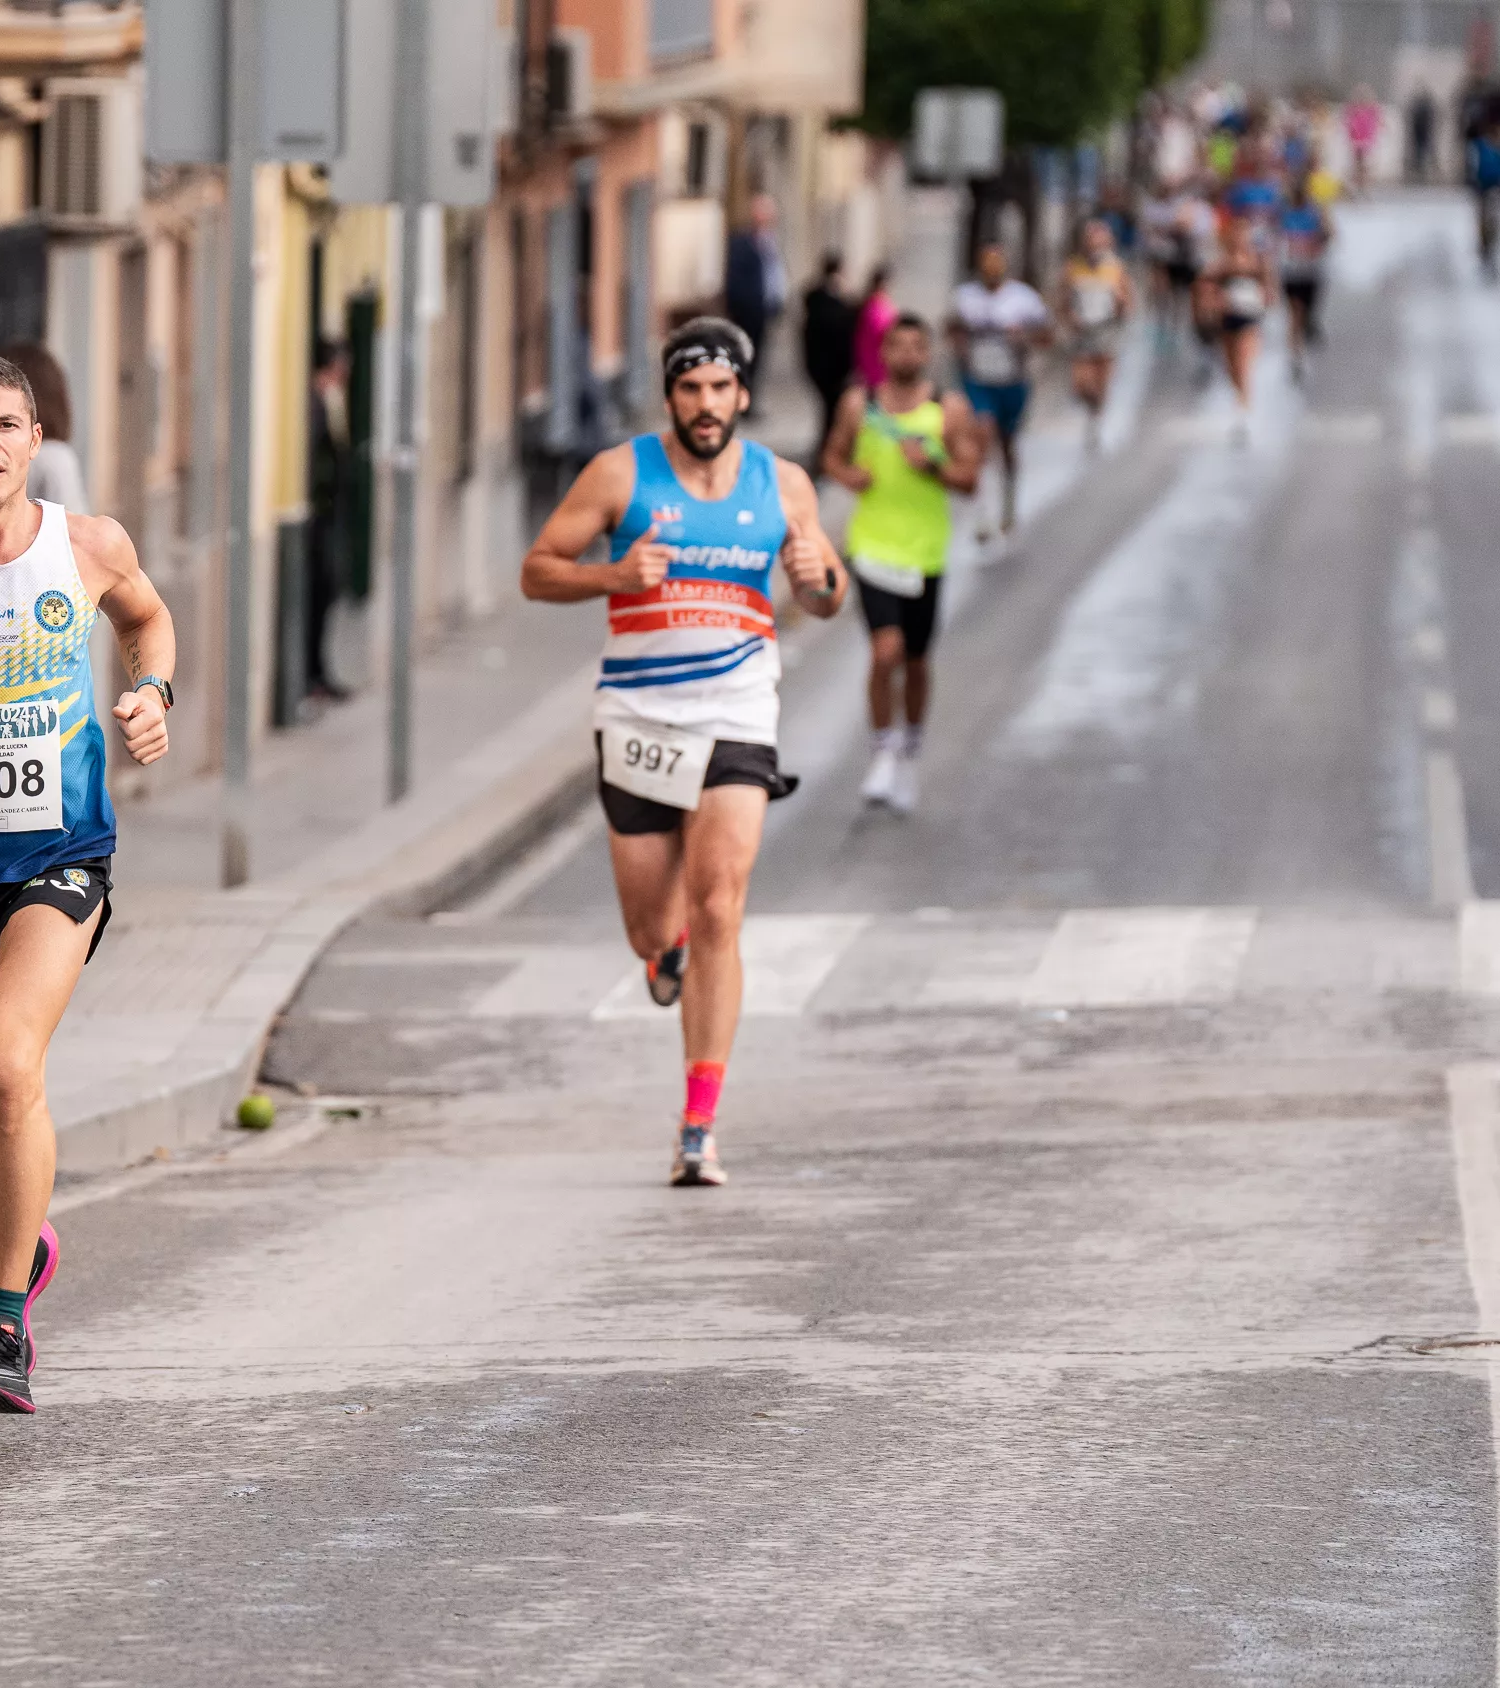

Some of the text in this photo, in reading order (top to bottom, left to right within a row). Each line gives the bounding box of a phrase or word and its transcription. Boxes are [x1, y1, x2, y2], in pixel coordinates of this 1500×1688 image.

[666, 609, 741, 628] Lucena
[624, 738, 684, 777] 997
[21, 805, 49, 813] CABRERA
